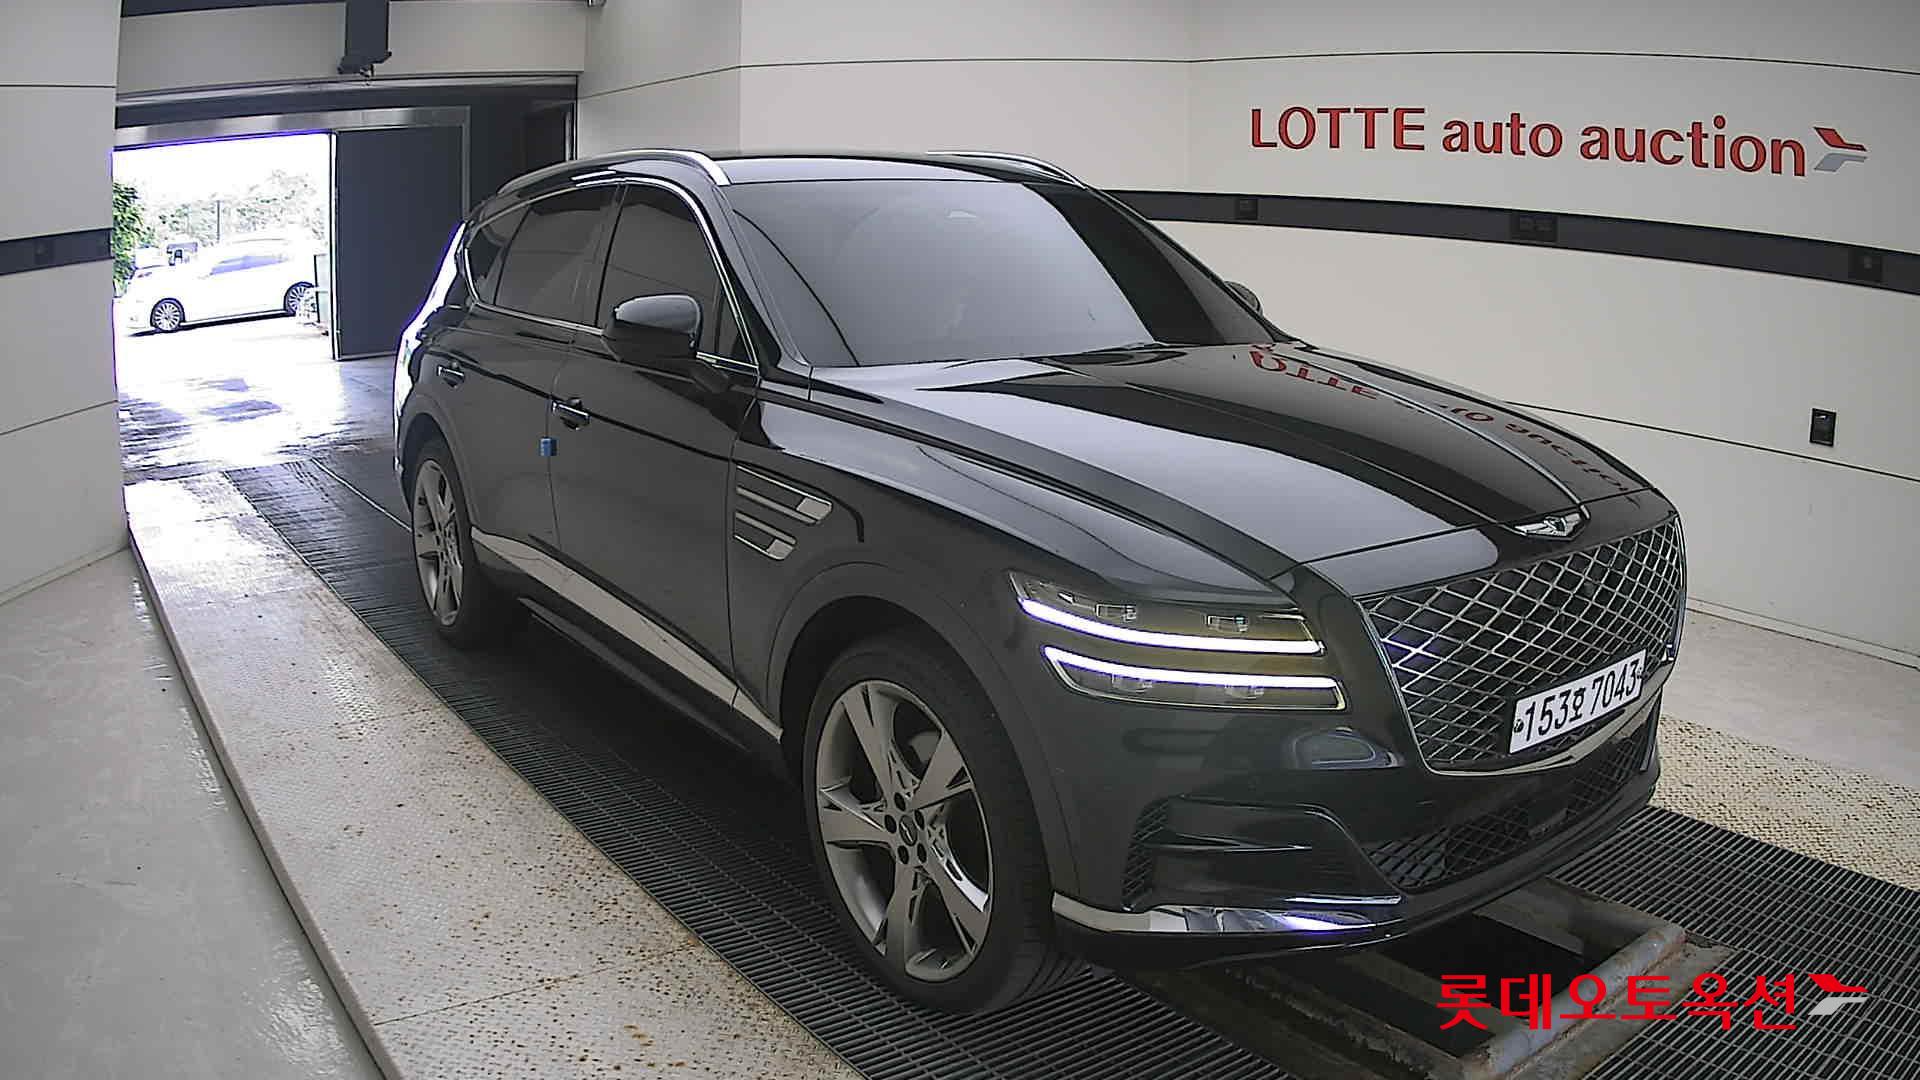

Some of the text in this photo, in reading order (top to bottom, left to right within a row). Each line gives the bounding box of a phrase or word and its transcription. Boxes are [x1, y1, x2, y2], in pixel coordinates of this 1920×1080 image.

[1251, 106, 1807, 177] LOTTE auto auction
[1590, 658, 1640, 716] 7043
